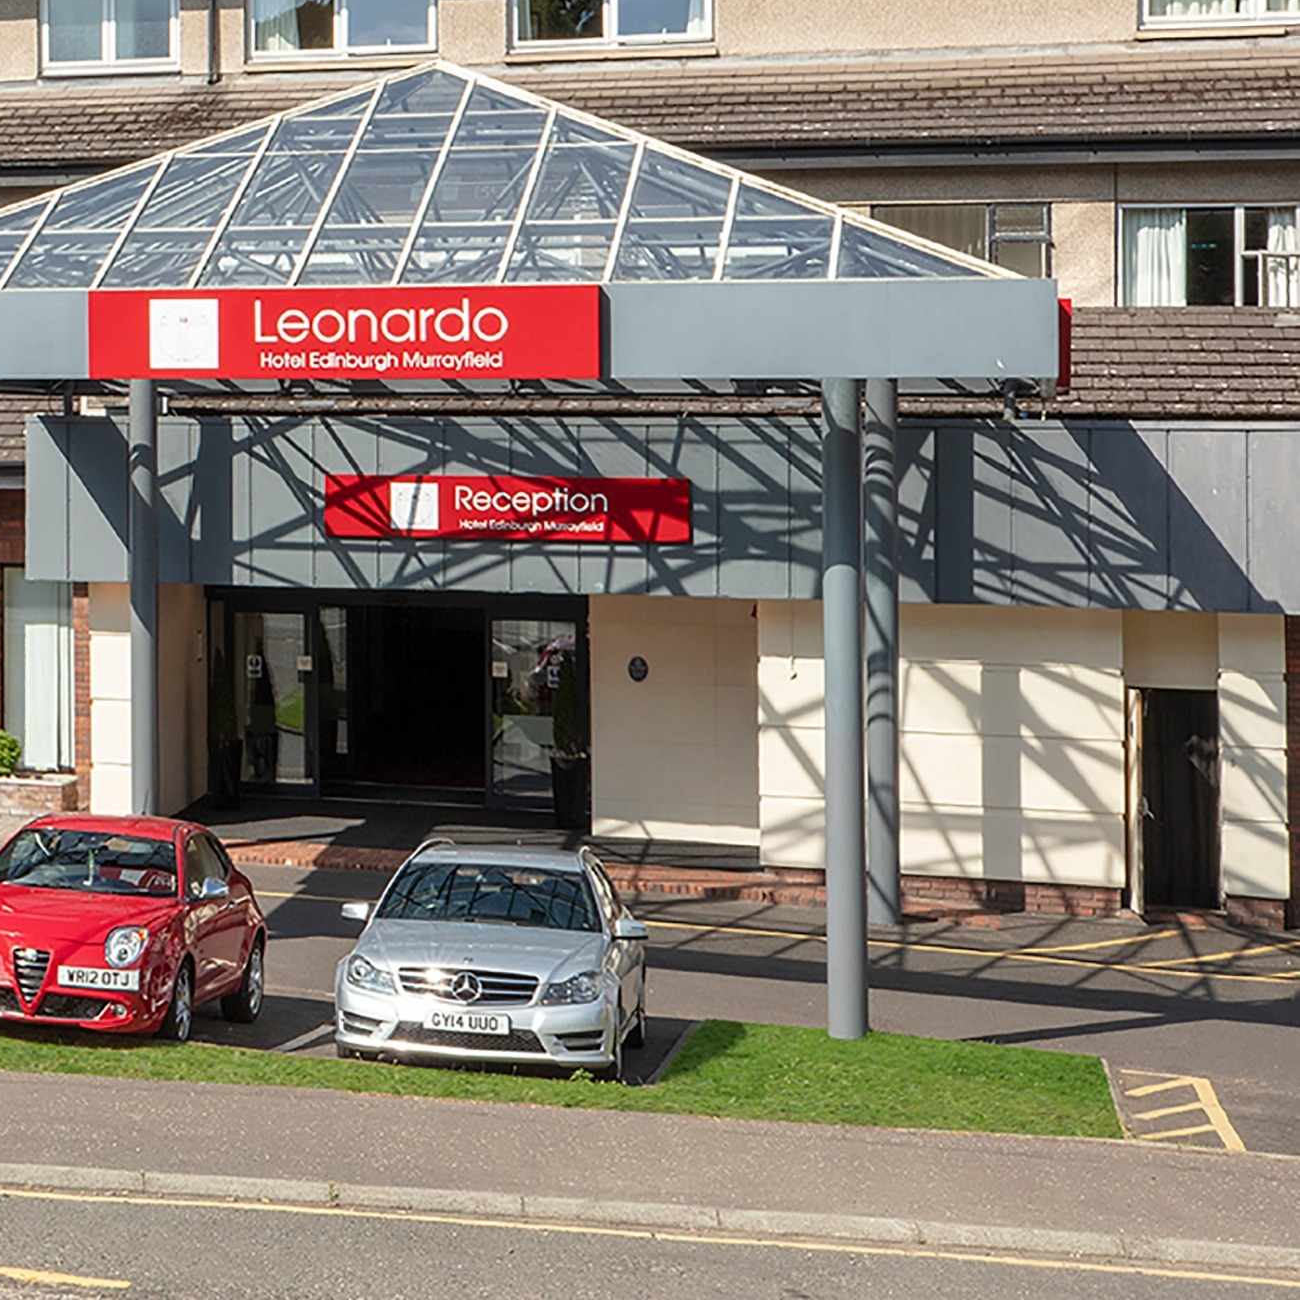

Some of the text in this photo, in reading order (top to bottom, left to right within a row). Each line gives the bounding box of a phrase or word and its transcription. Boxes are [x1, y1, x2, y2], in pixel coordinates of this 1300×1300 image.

[254, 298, 509, 343] Leonardo
[259, 351, 503, 372] Hotel Edinburgh Murrayfield
[454, 485, 608, 517] Reception
[459, 519, 604, 533] Hotel Edinburgh Murrayfield
[101, 971, 130, 987] OTJ
[432, 1012, 499, 1031] GY14 UUO
